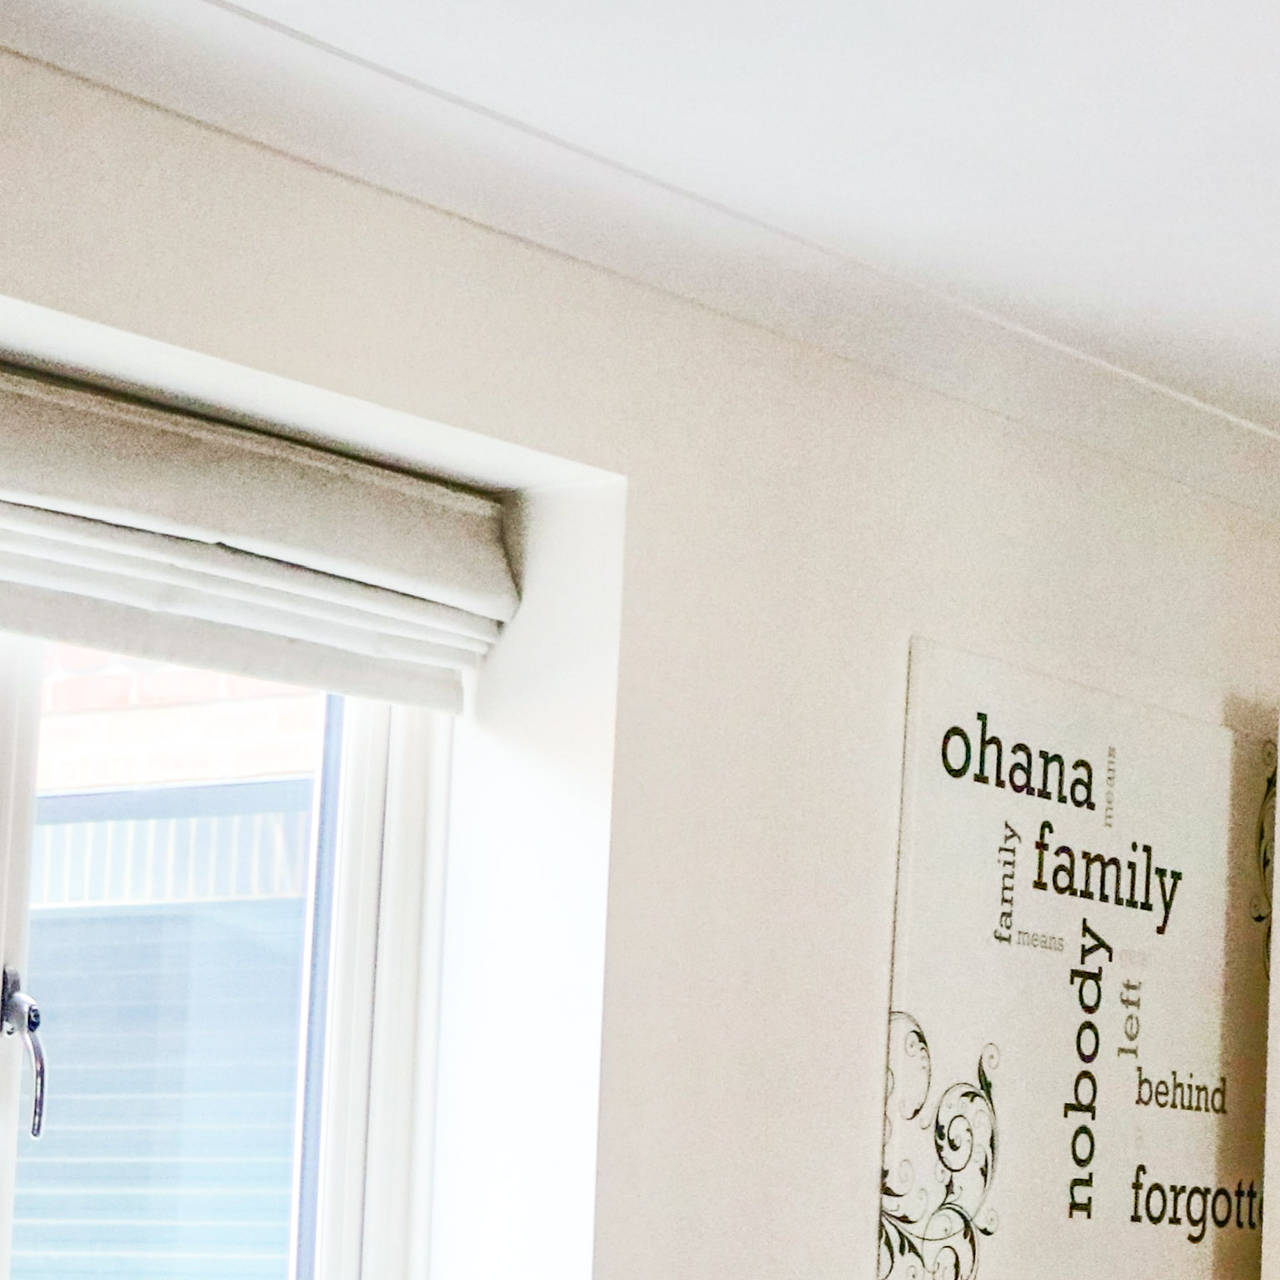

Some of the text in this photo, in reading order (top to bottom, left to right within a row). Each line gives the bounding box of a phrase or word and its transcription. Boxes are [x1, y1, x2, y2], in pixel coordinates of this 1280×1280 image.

[941, 712, 1097, 811] ohana
[994, 820, 1023, 945] family
[1032, 820, 1183, 935] family
[1016, 927, 1065, 953] means
[1117, 978, 1143, 1059] left
[1064, 918, 1113, 1221] nobody
[1135, 1065, 1228, 1115] behind
[1130, 1164, 1264, 1244] forgott
